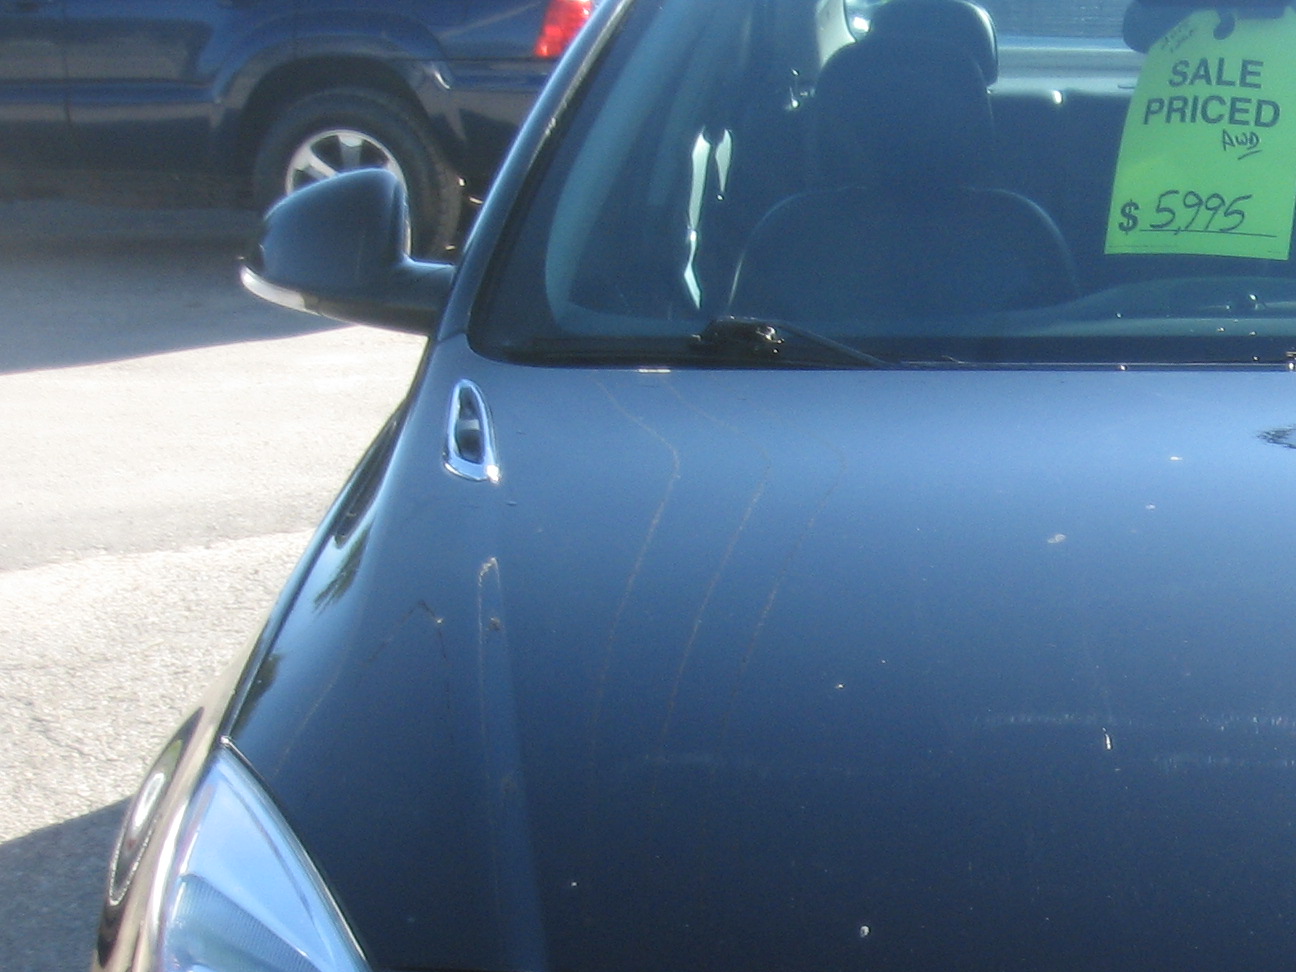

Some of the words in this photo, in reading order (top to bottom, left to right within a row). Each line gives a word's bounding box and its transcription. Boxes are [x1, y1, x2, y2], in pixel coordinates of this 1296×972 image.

[1168, 57, 1264, 89] SALE
[1143, 95, 1281, 128] PRICED
[1221, 129, 1261, 151] AWD
